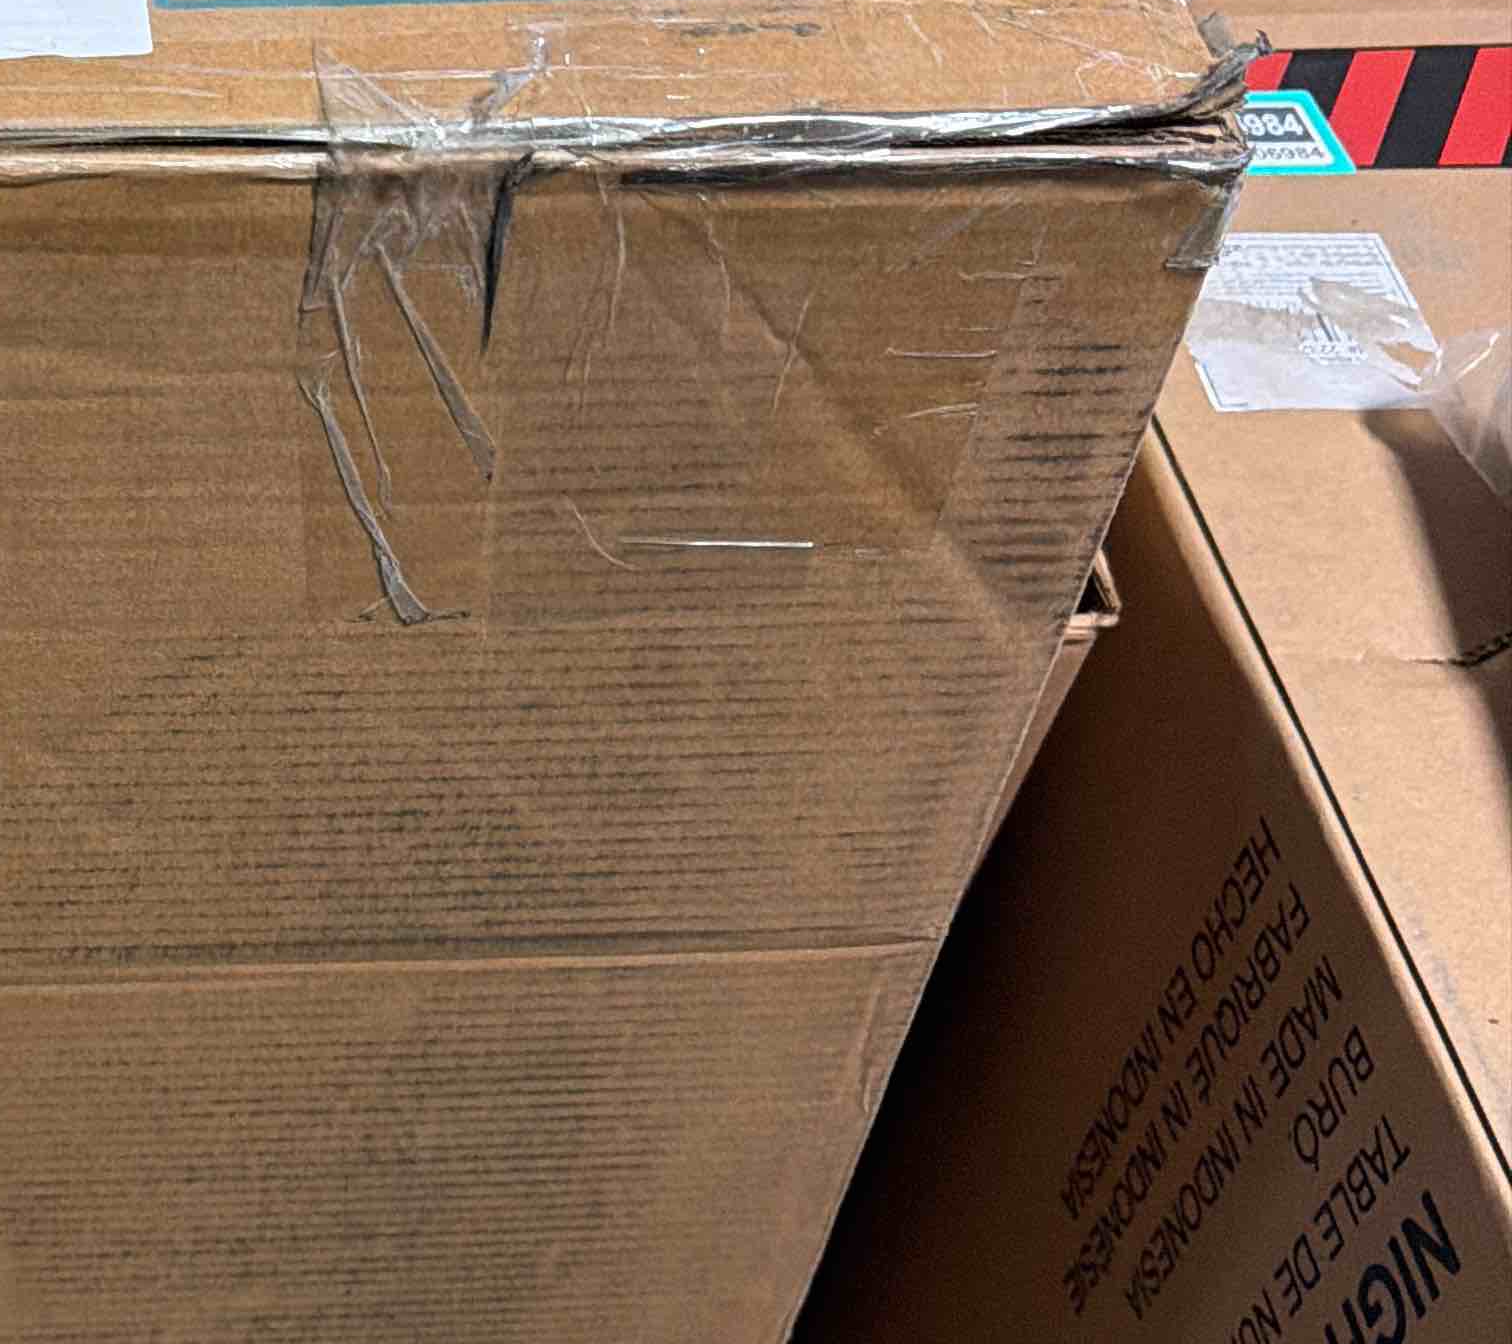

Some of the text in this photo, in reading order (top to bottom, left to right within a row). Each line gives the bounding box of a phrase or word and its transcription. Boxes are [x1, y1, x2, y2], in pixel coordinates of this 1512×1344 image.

[1157, 965, 1200, 1046] EN
[1125, 955, 1344, 1322] MADE IN INDONESIA
[1313, 1114, 1411, 1262] TABLE
[1273, 1232, 1322, 1319] DE
